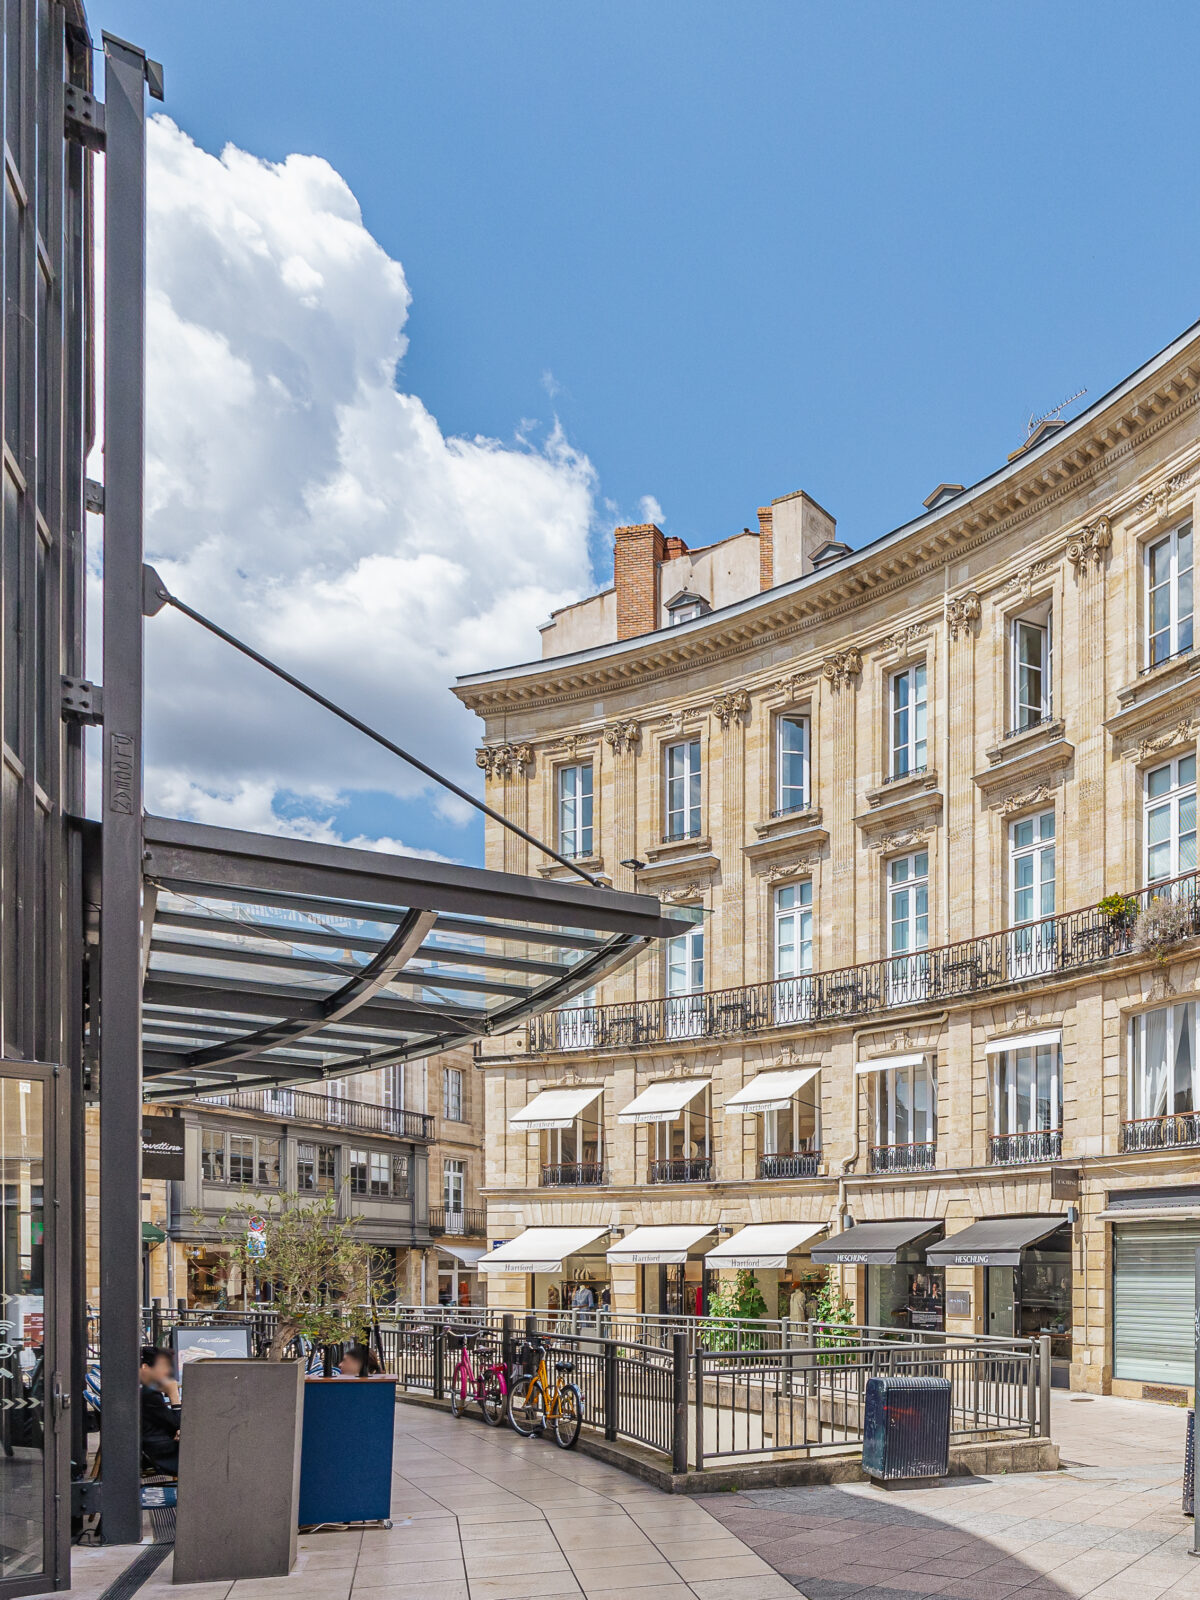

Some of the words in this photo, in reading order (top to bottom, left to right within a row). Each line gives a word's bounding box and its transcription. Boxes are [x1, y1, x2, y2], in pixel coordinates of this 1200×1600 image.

[743, 1103, 772, 1112] Hartford
[634, 1113, 663, 1122] Hartford
[527, 1121, 555, 1129] Hartford
[632, 1254, 661, 1262] Hartford
[836, 1254, 868, 1262] HESCHUNG
[955, 1255, 989, 1263] HESCHUNG
[504, 1263, 534, 1271] Hartford
[731, 1259, 760, 1267] Hartford
